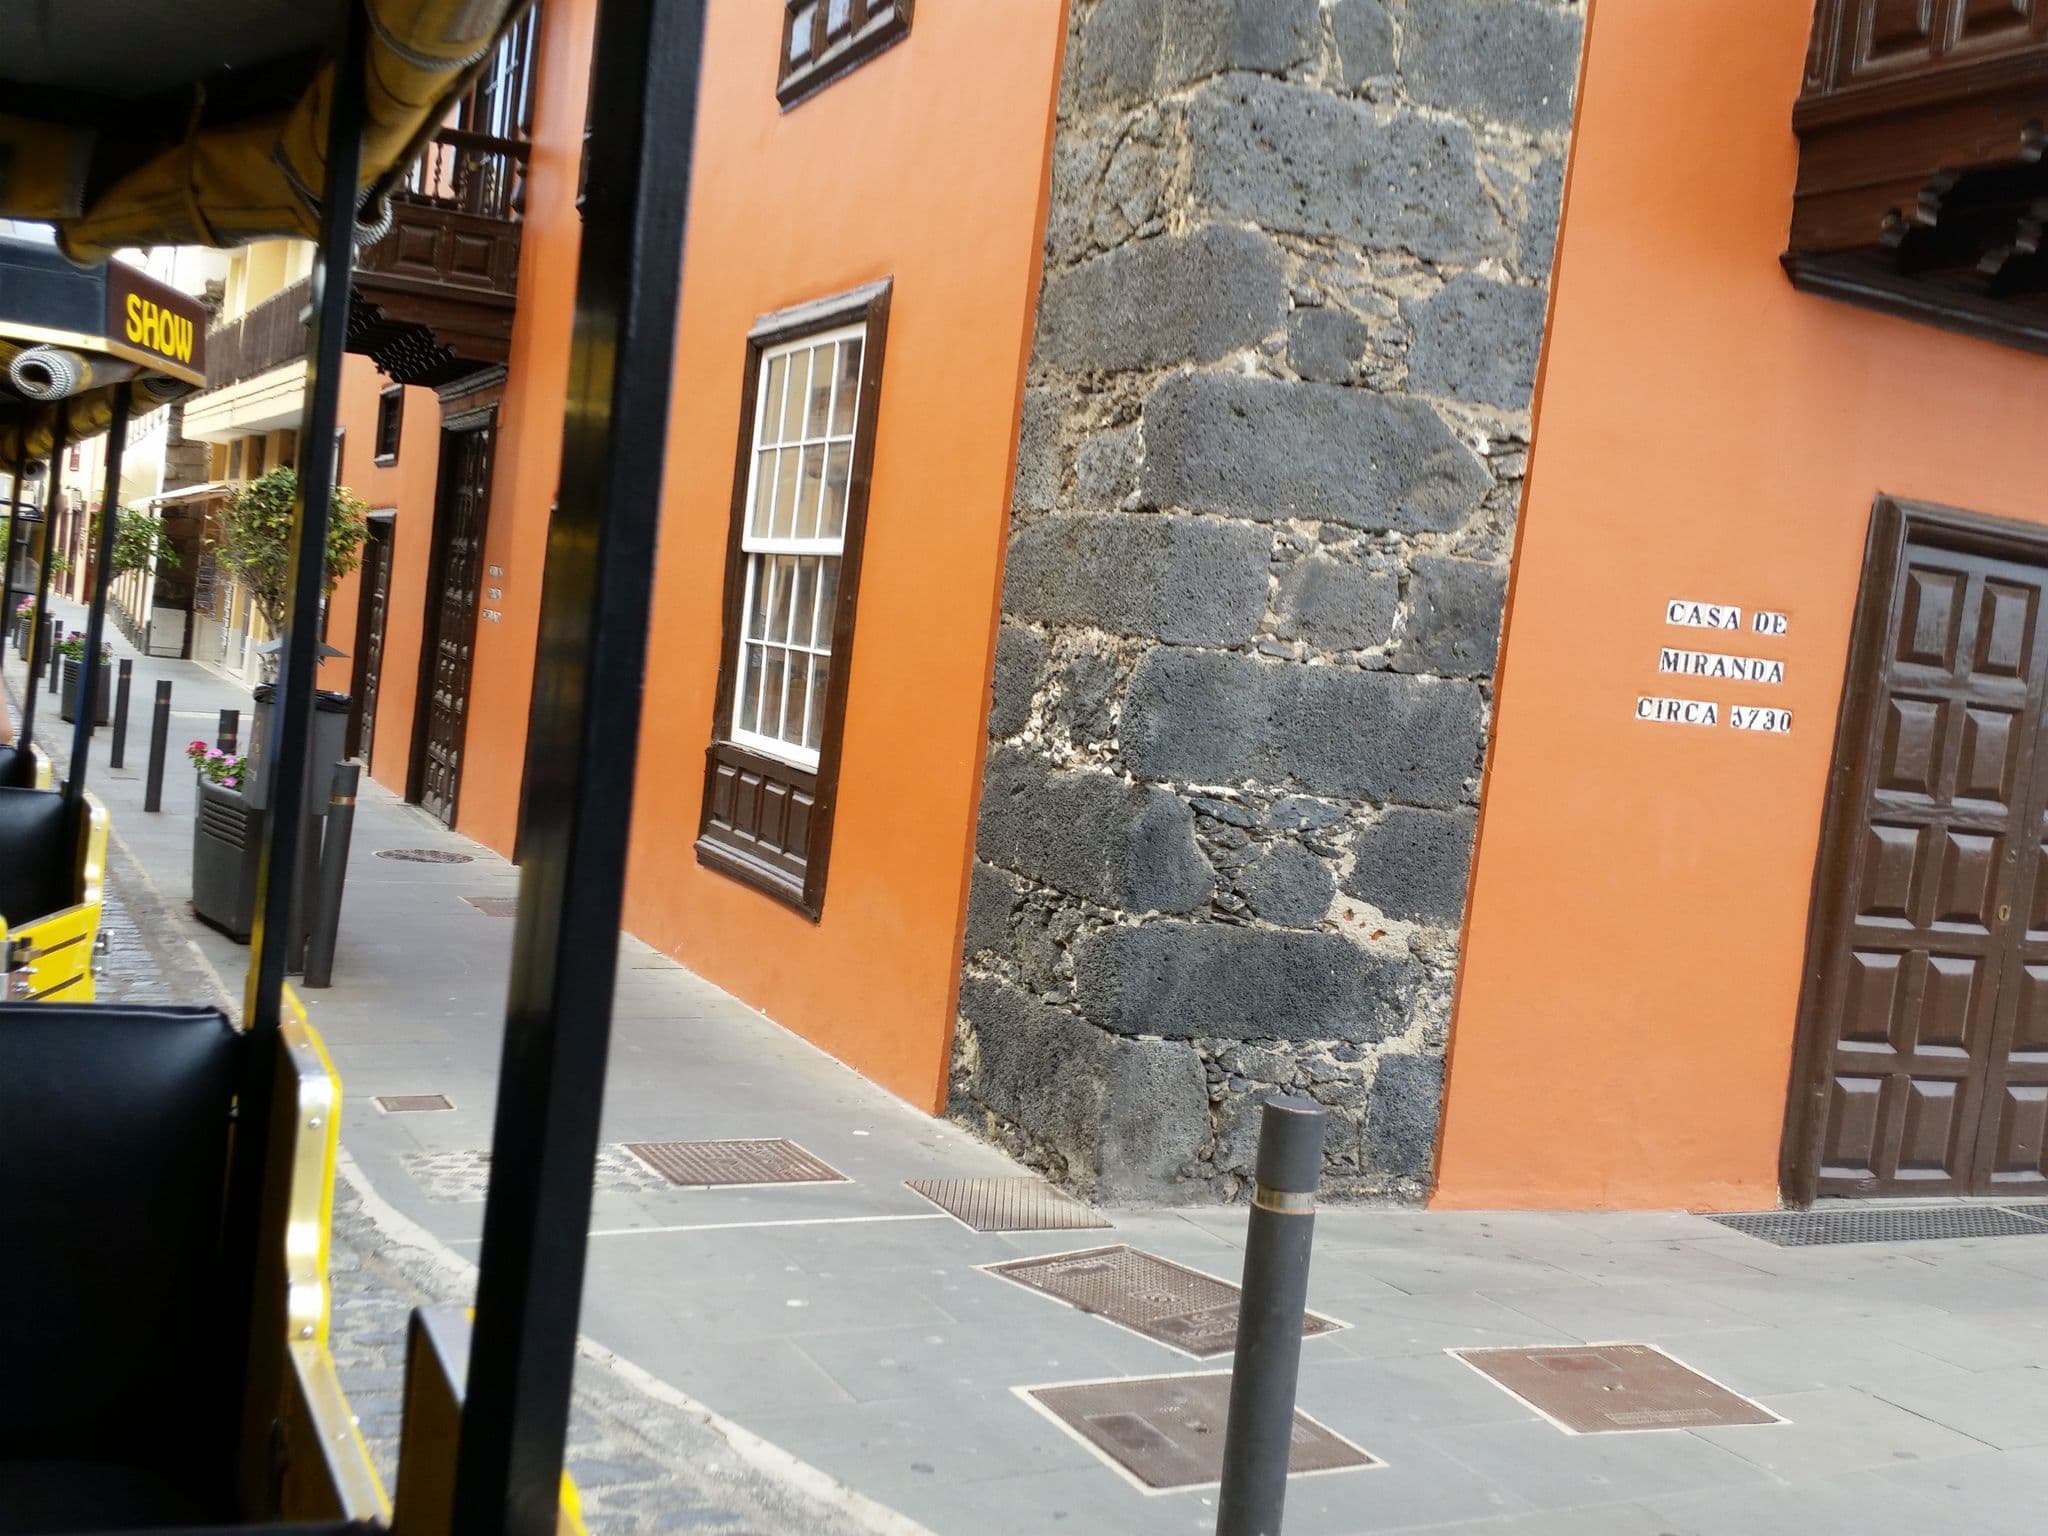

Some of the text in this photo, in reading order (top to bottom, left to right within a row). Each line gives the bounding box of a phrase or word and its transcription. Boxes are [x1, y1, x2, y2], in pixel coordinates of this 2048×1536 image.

[126, 293, 193, 364] SHOW
[1669, 603, 1787, 634] CASA DE
[1661, 650, 1782, 682] MIRANDA
[1637, 698, 1716, 724] CIRCA
